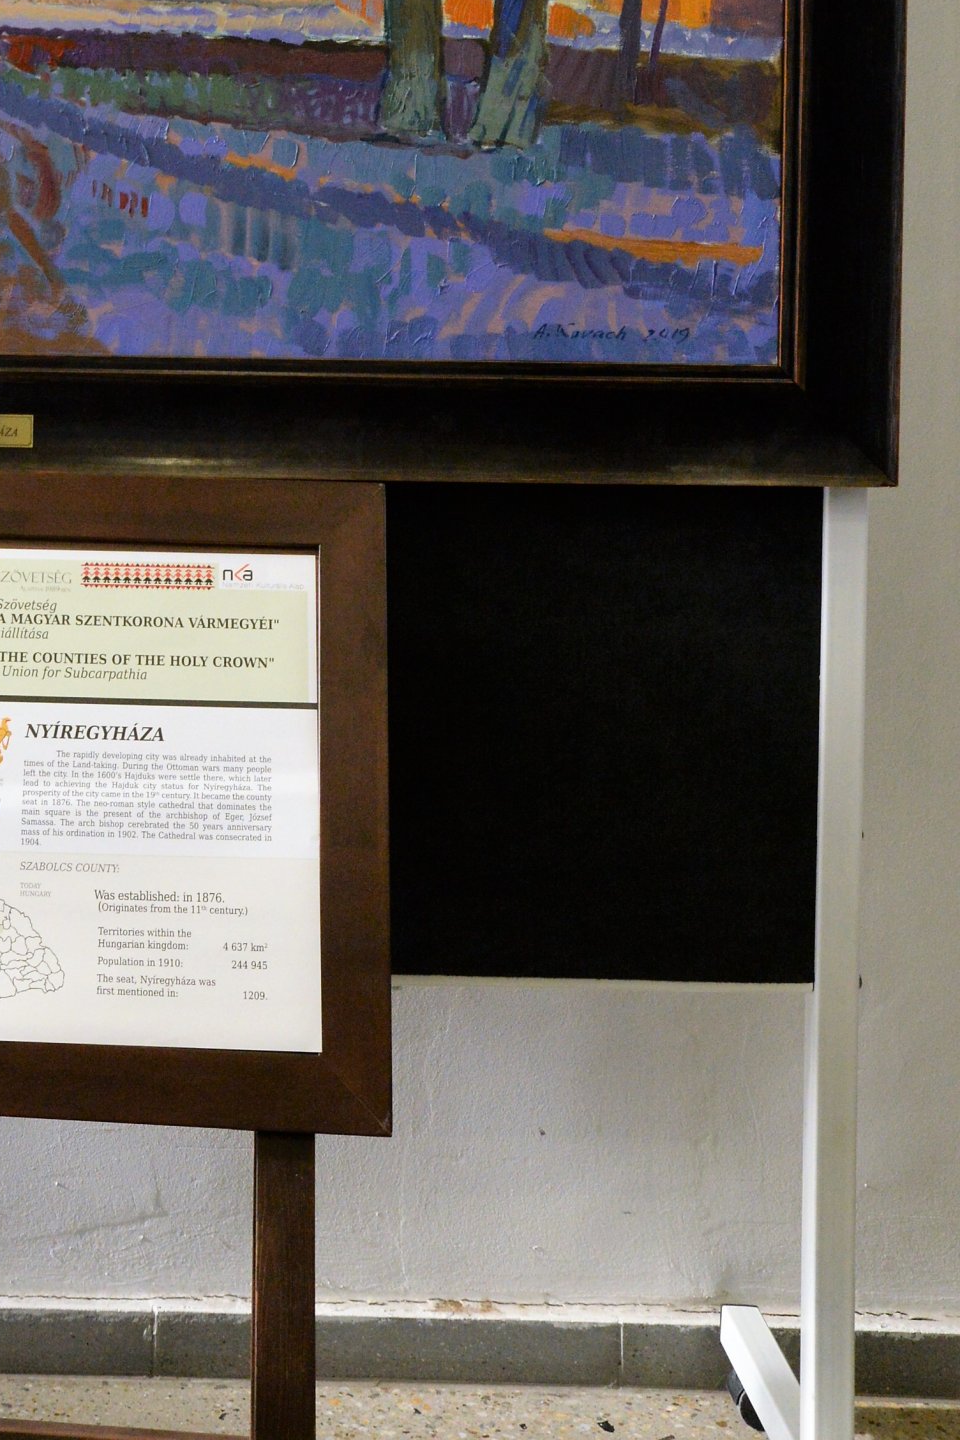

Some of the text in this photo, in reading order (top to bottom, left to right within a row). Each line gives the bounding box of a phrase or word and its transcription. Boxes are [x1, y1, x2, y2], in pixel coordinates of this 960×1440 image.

[9, 612, 70, 625] MAGYAR
[75, 614, 183, 627] SZENTKORONA
[188, 614, 279, 629] VÁRMEGYÉI"
[32, 651, 107, 664] COUNTIES
[111, 653, 131, 665] OF
[134, 654, 165, 665] THE
[170, 654, 208, 666] HOLY
[212, 655, 274, 668] CROWN"
[1, 665, 38, 677] Union
[41, 665, 61, 680] for
[65, 666, 146, 682] Subcarpathia
[25, 720, 163, 742] NYÍREGYHÁZA
[56, 750, 70, 758] The
[72, 750, 99, 761] rapidly
[102, 751, 143, 762] developing
[145, 752, 159, 762] city
[179, 752, 208, 763] already
[210, 753, 246, 762] inhabited
[258, 754, 271, 762] the
[21, 798, 37, 806] seat
[40, 798, 48, 806] in
[51, 798, 73, 806] 1876.
[76, 798, 90, 806] The
[137, 800, 155, 810] style
[158, 800, 194, 808] cathedral
[197, 801, 213, 809] that
[216, 801, 255, 810] dominates
[259, 802, 272, 810] the
[42, 828, 50, 836] of
[52, 828, 63, 836] his
[66, 829, 104, 837] ordination
[117, 830, 138, 838] 1902.
[141, 830, 155, 838] The
[158, 831, 195, 839] Cathedral
[216, 832, 261, 840] consecrated
[20, 837, 41, 845] 1904.
[19, 861, 120, 872] SZABOLCS COUNTY:
[94, 890, 224, 902] Was established: in 1876.
[98, 902, 147, 914] (Originates
[150, 903, 171, 913] from
[173, 904, 188, 913] the
[209, 904, 248, 916] century.)
[97, 927, 192, 936] Territories within the
[97, 939, 188, 951] Hungarian kingdom:
[231, 942, 248, 951] 637
[97, 956, 183, 968] Population in 1910:
[231, 960, 268, 969] 244 945
[96, 974, 114, 983] The
[115, 975, 137, 985] seat,
[140, 974, 196, 987] Nyíregyháza
[96, 986, 179, 996] first mentioned in:
[243, 990, 267, 1000] 1209.
